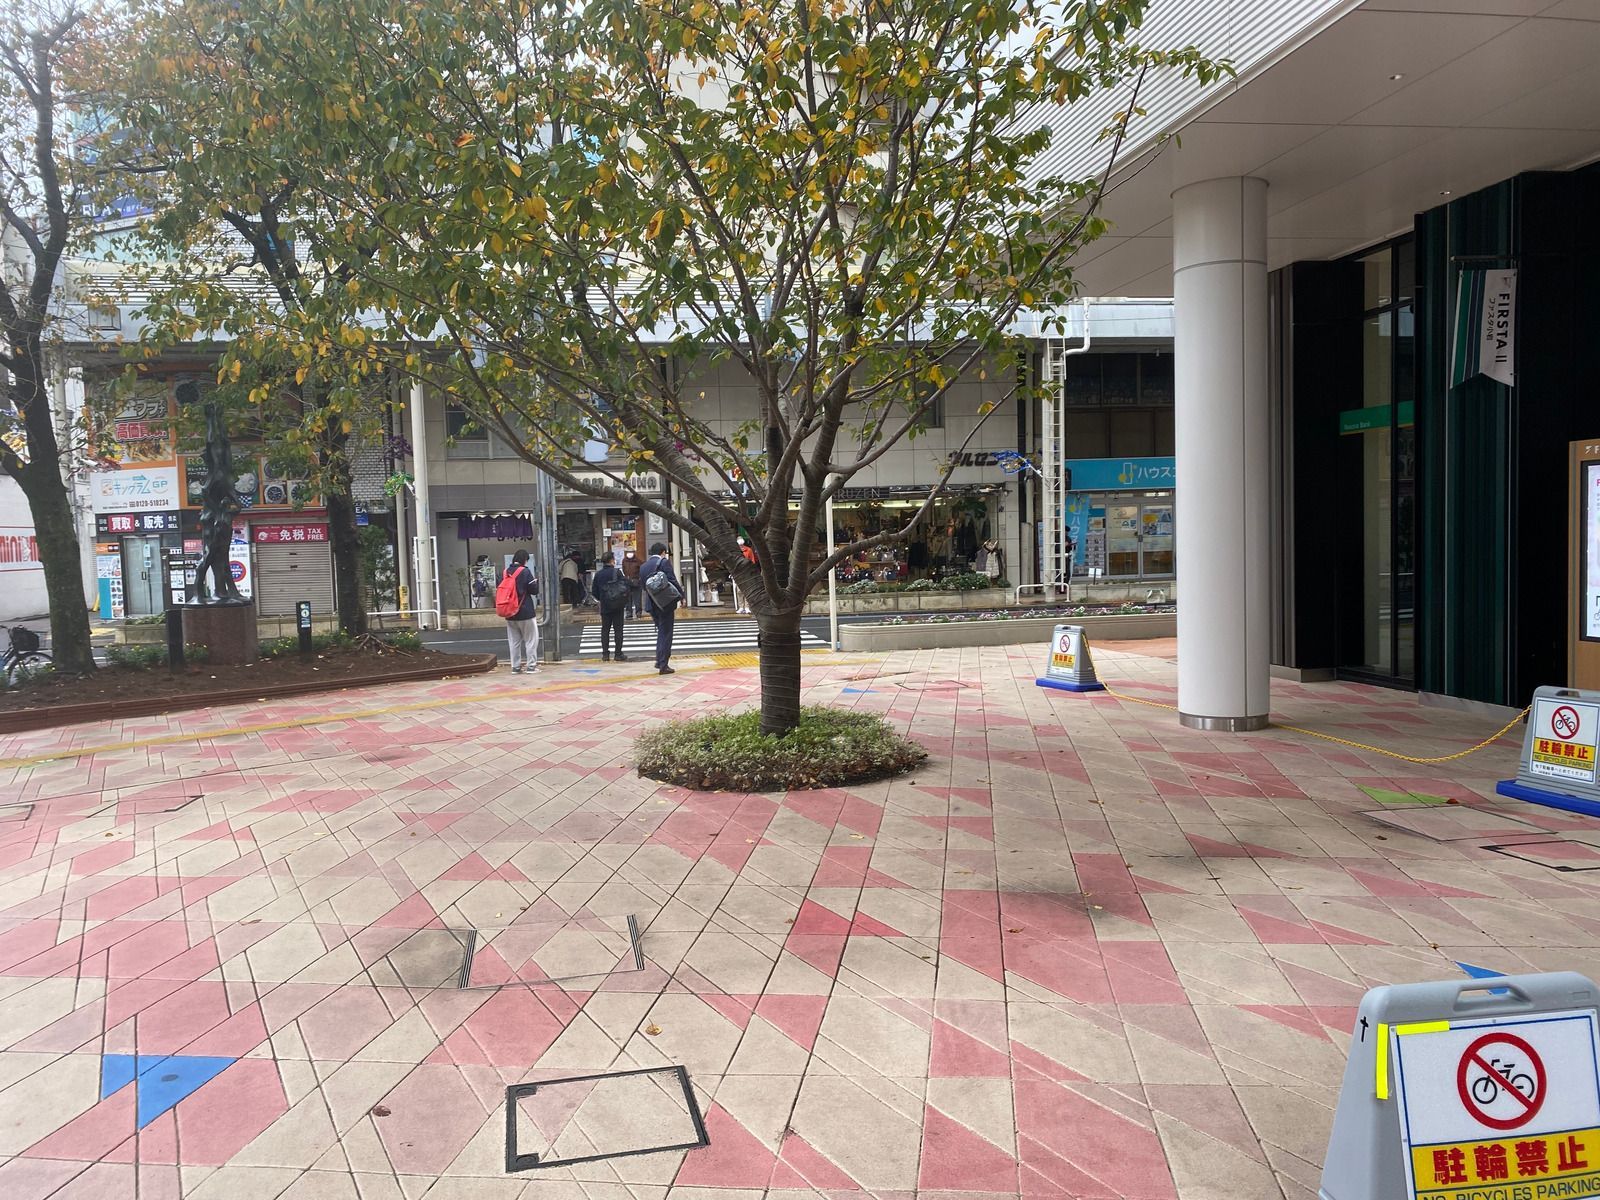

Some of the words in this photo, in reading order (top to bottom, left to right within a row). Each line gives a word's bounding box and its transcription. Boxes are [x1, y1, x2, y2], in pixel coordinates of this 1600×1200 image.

[1495, 292, 1510, 350] FIRSTA
[152, 480, 168, 488] GP
[111, 516, 132, 531] 買取
[134, 519, 140, 527] &
[143, 515, 164, 529] 販売
[279, 529, 305, 541] 免税
[1539, 740, 1588, 759] 駐輪禁止
[1432, 1136, 1589, 1186] 駐輪禁止
[1537, 1178, 1600, 1198] PARKING
